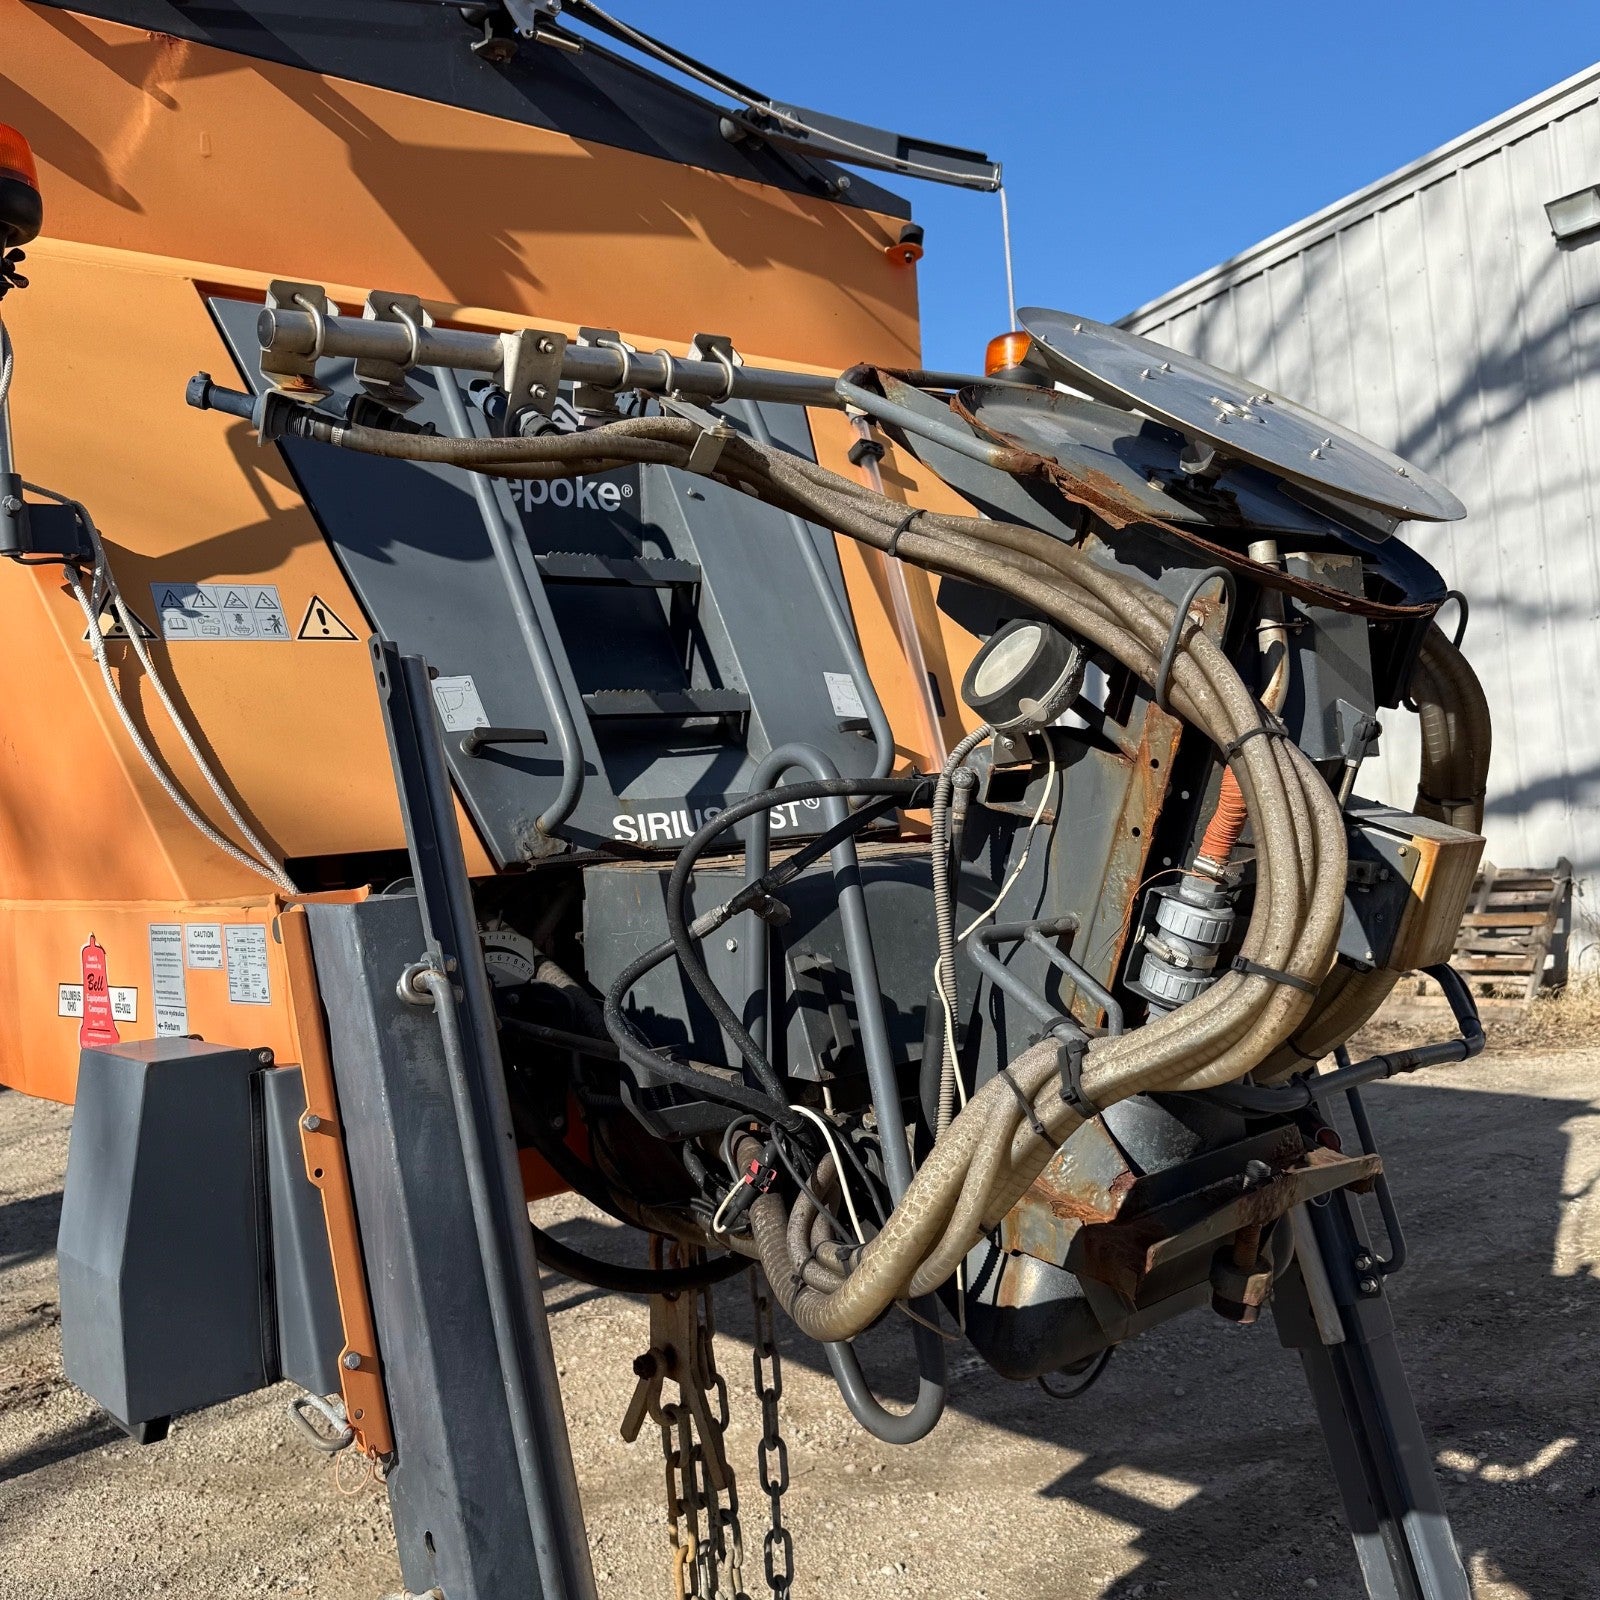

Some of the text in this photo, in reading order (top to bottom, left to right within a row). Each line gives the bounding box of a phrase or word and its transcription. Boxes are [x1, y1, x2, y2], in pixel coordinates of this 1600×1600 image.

[87, 973, 104, 991] Bell
[61, 990, 81, 1001] COLUMBUS
[87, 994, 108, 1003] Equipment
[67, 1001, 77, 1012] OHIO
[88, 1004, 107, 1015] Company
[164, 1022, 180, 1031] Return
